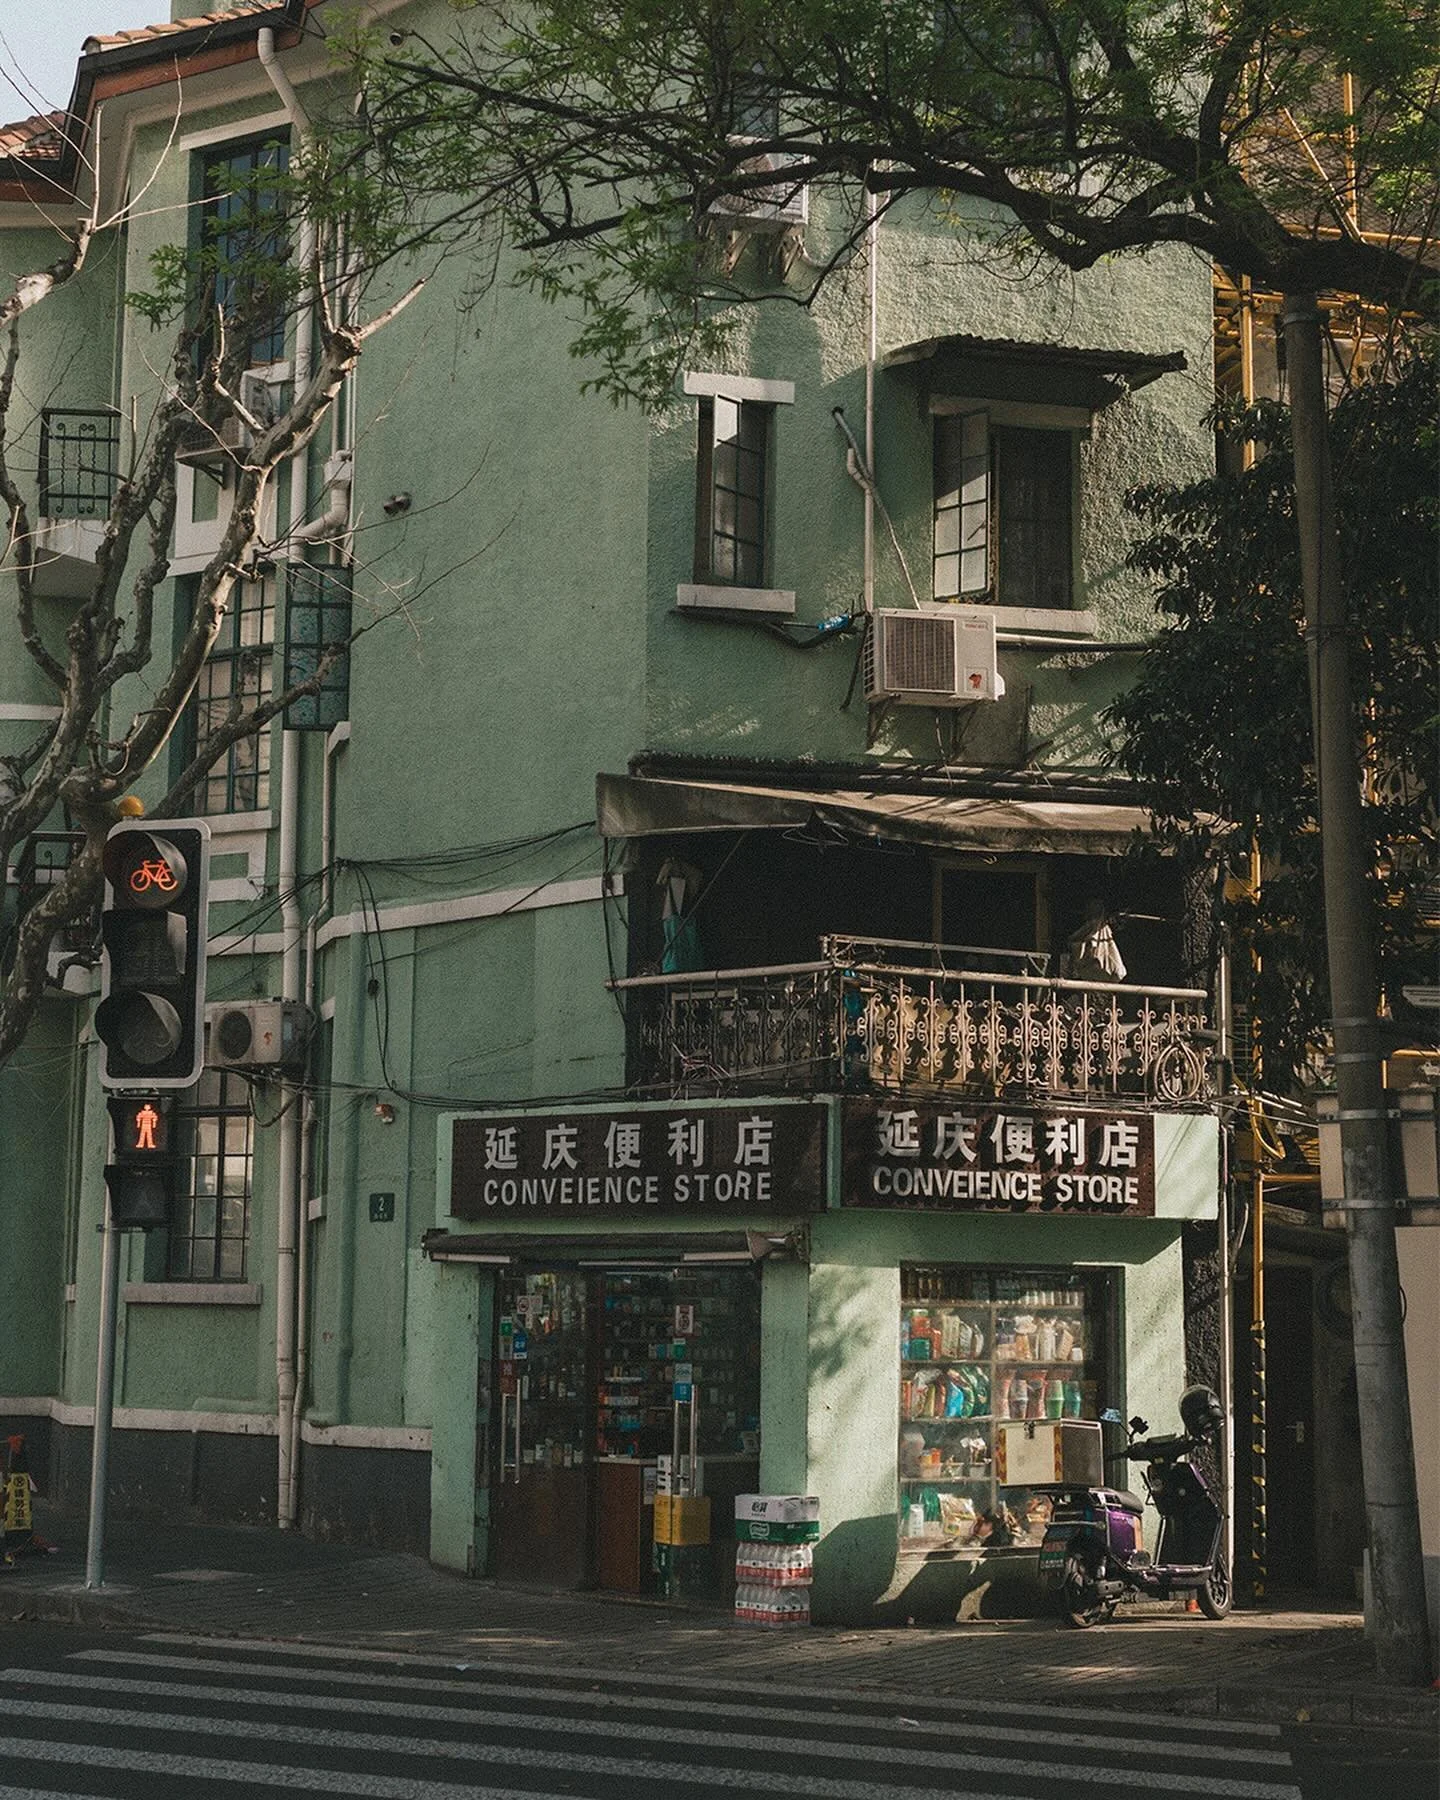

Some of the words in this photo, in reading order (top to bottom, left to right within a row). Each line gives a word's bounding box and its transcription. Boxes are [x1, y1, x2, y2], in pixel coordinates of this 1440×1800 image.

[484, 1115, 774, 1170] 延庆便利店
[876, 1109, 1139, 1168] 延庆便利店
[483, 1175, 659, 1206] CONVEIENCE
[673, 1170, 772, 1203] STORE
[873, 1166, 1042, 1202] CONVEIENCE
[1056, 1173, 1138, 1205] STORE
